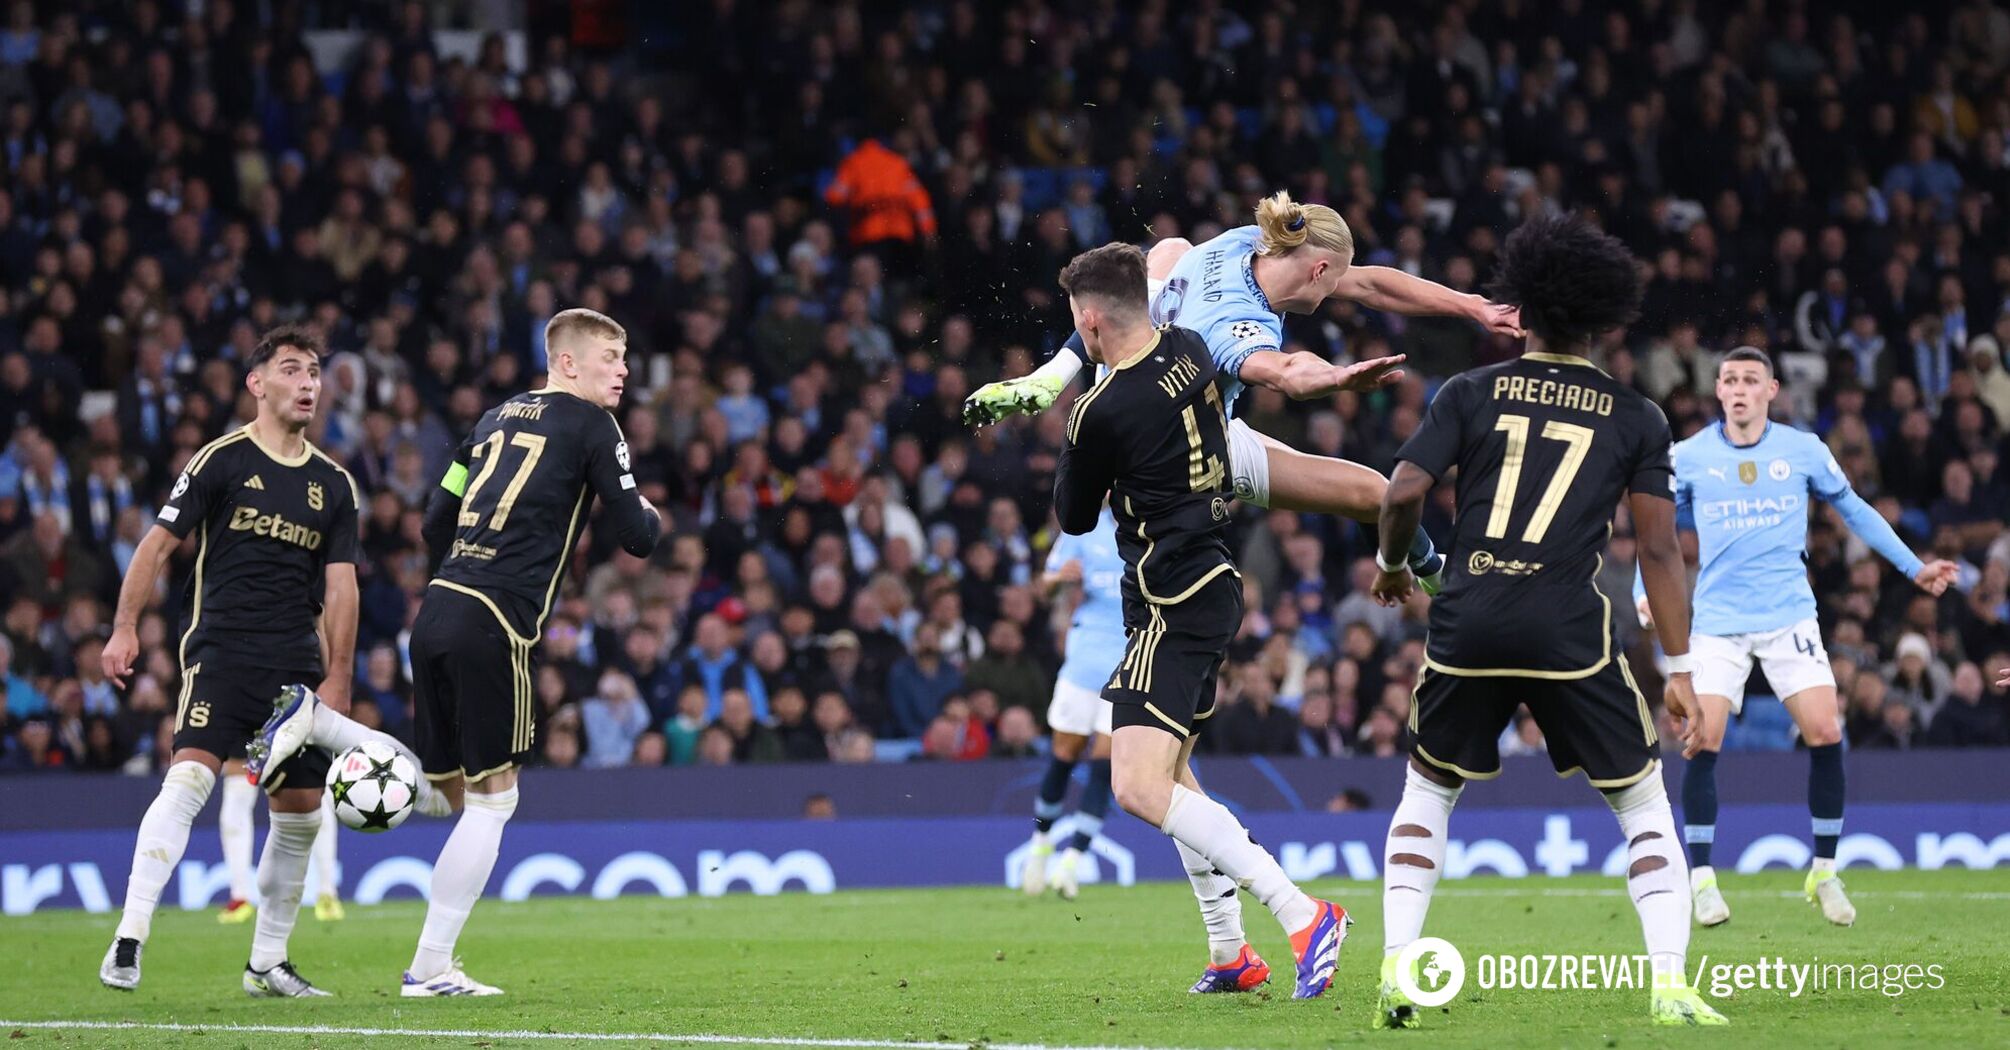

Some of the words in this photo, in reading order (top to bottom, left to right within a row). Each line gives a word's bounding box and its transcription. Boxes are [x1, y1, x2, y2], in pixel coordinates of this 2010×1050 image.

[1493, 376, 1614, 417] PRECIADO
[457, 429, 548, 532] 27
[1485, 414, 1595, 544] 17
[1702, 494, 1800, 519] ETIHAD
[1723, 514, 1781, 530] AIRWAYS
[229, 506, 321, 550] Betano
